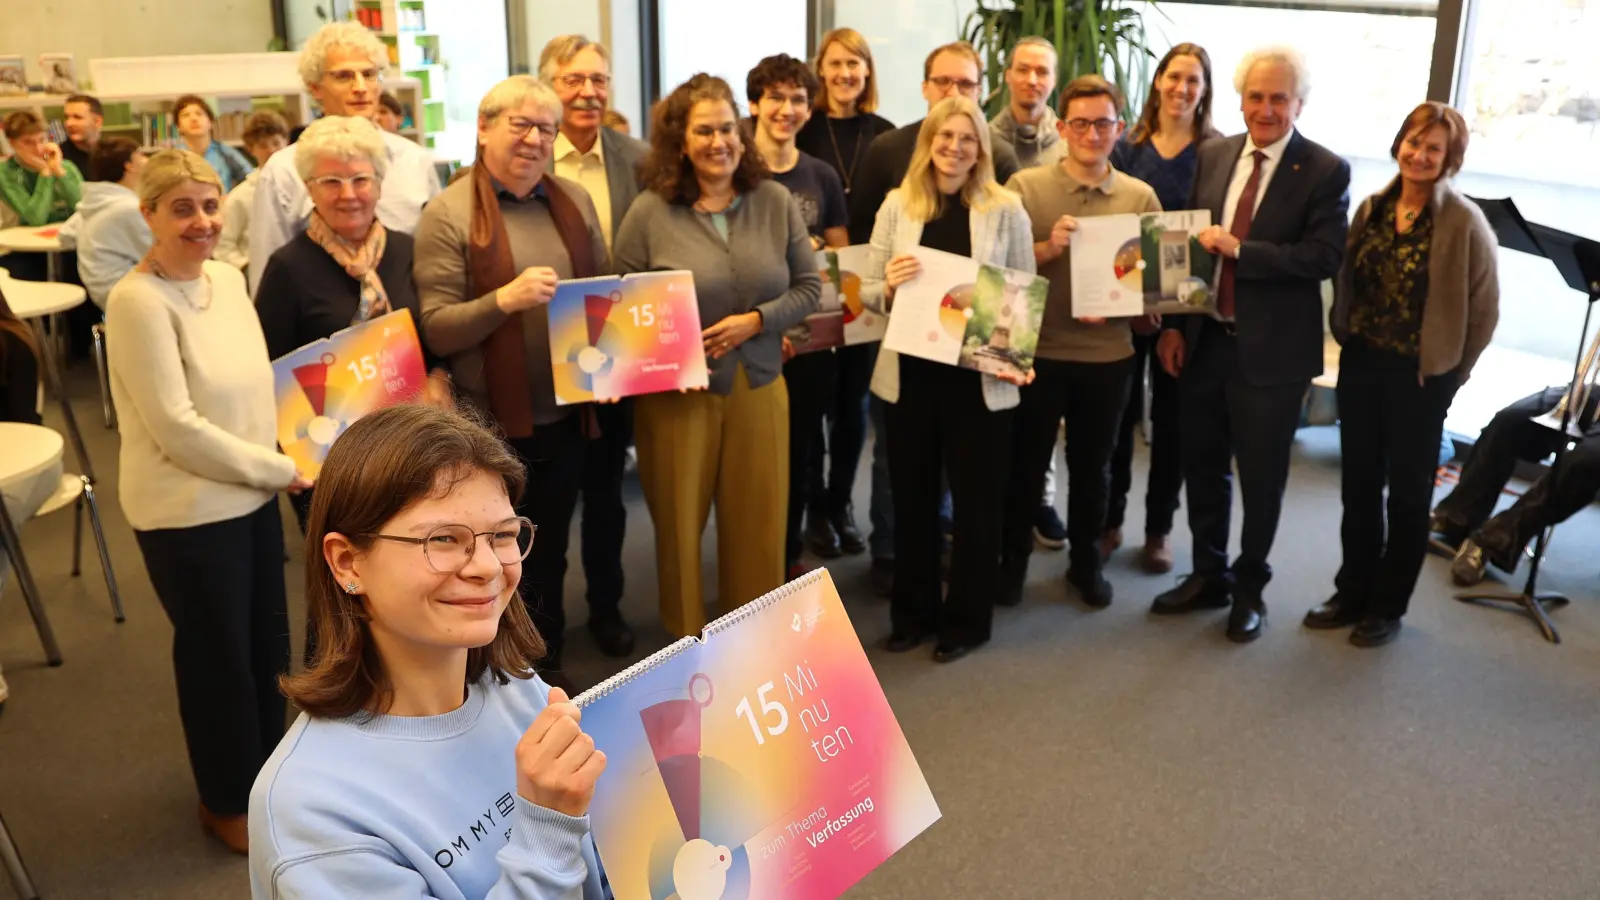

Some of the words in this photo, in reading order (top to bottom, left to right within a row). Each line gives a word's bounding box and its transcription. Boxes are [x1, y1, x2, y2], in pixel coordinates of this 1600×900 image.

[628, 303, 655, 327] 15
[347, 355, 377, 384] 15
[735, 680, 789, 746] 15
[784, 659, 818, 702] Mi
[798, 699, 830, 733] nu
[810, 724, 854, 763] ten
[434, 808, 496, 869] OMMY
[760, 834, 787, 859] zum
[785, 806, 828, 839] Thema
[806, 796, 875, 849] Verfassung
